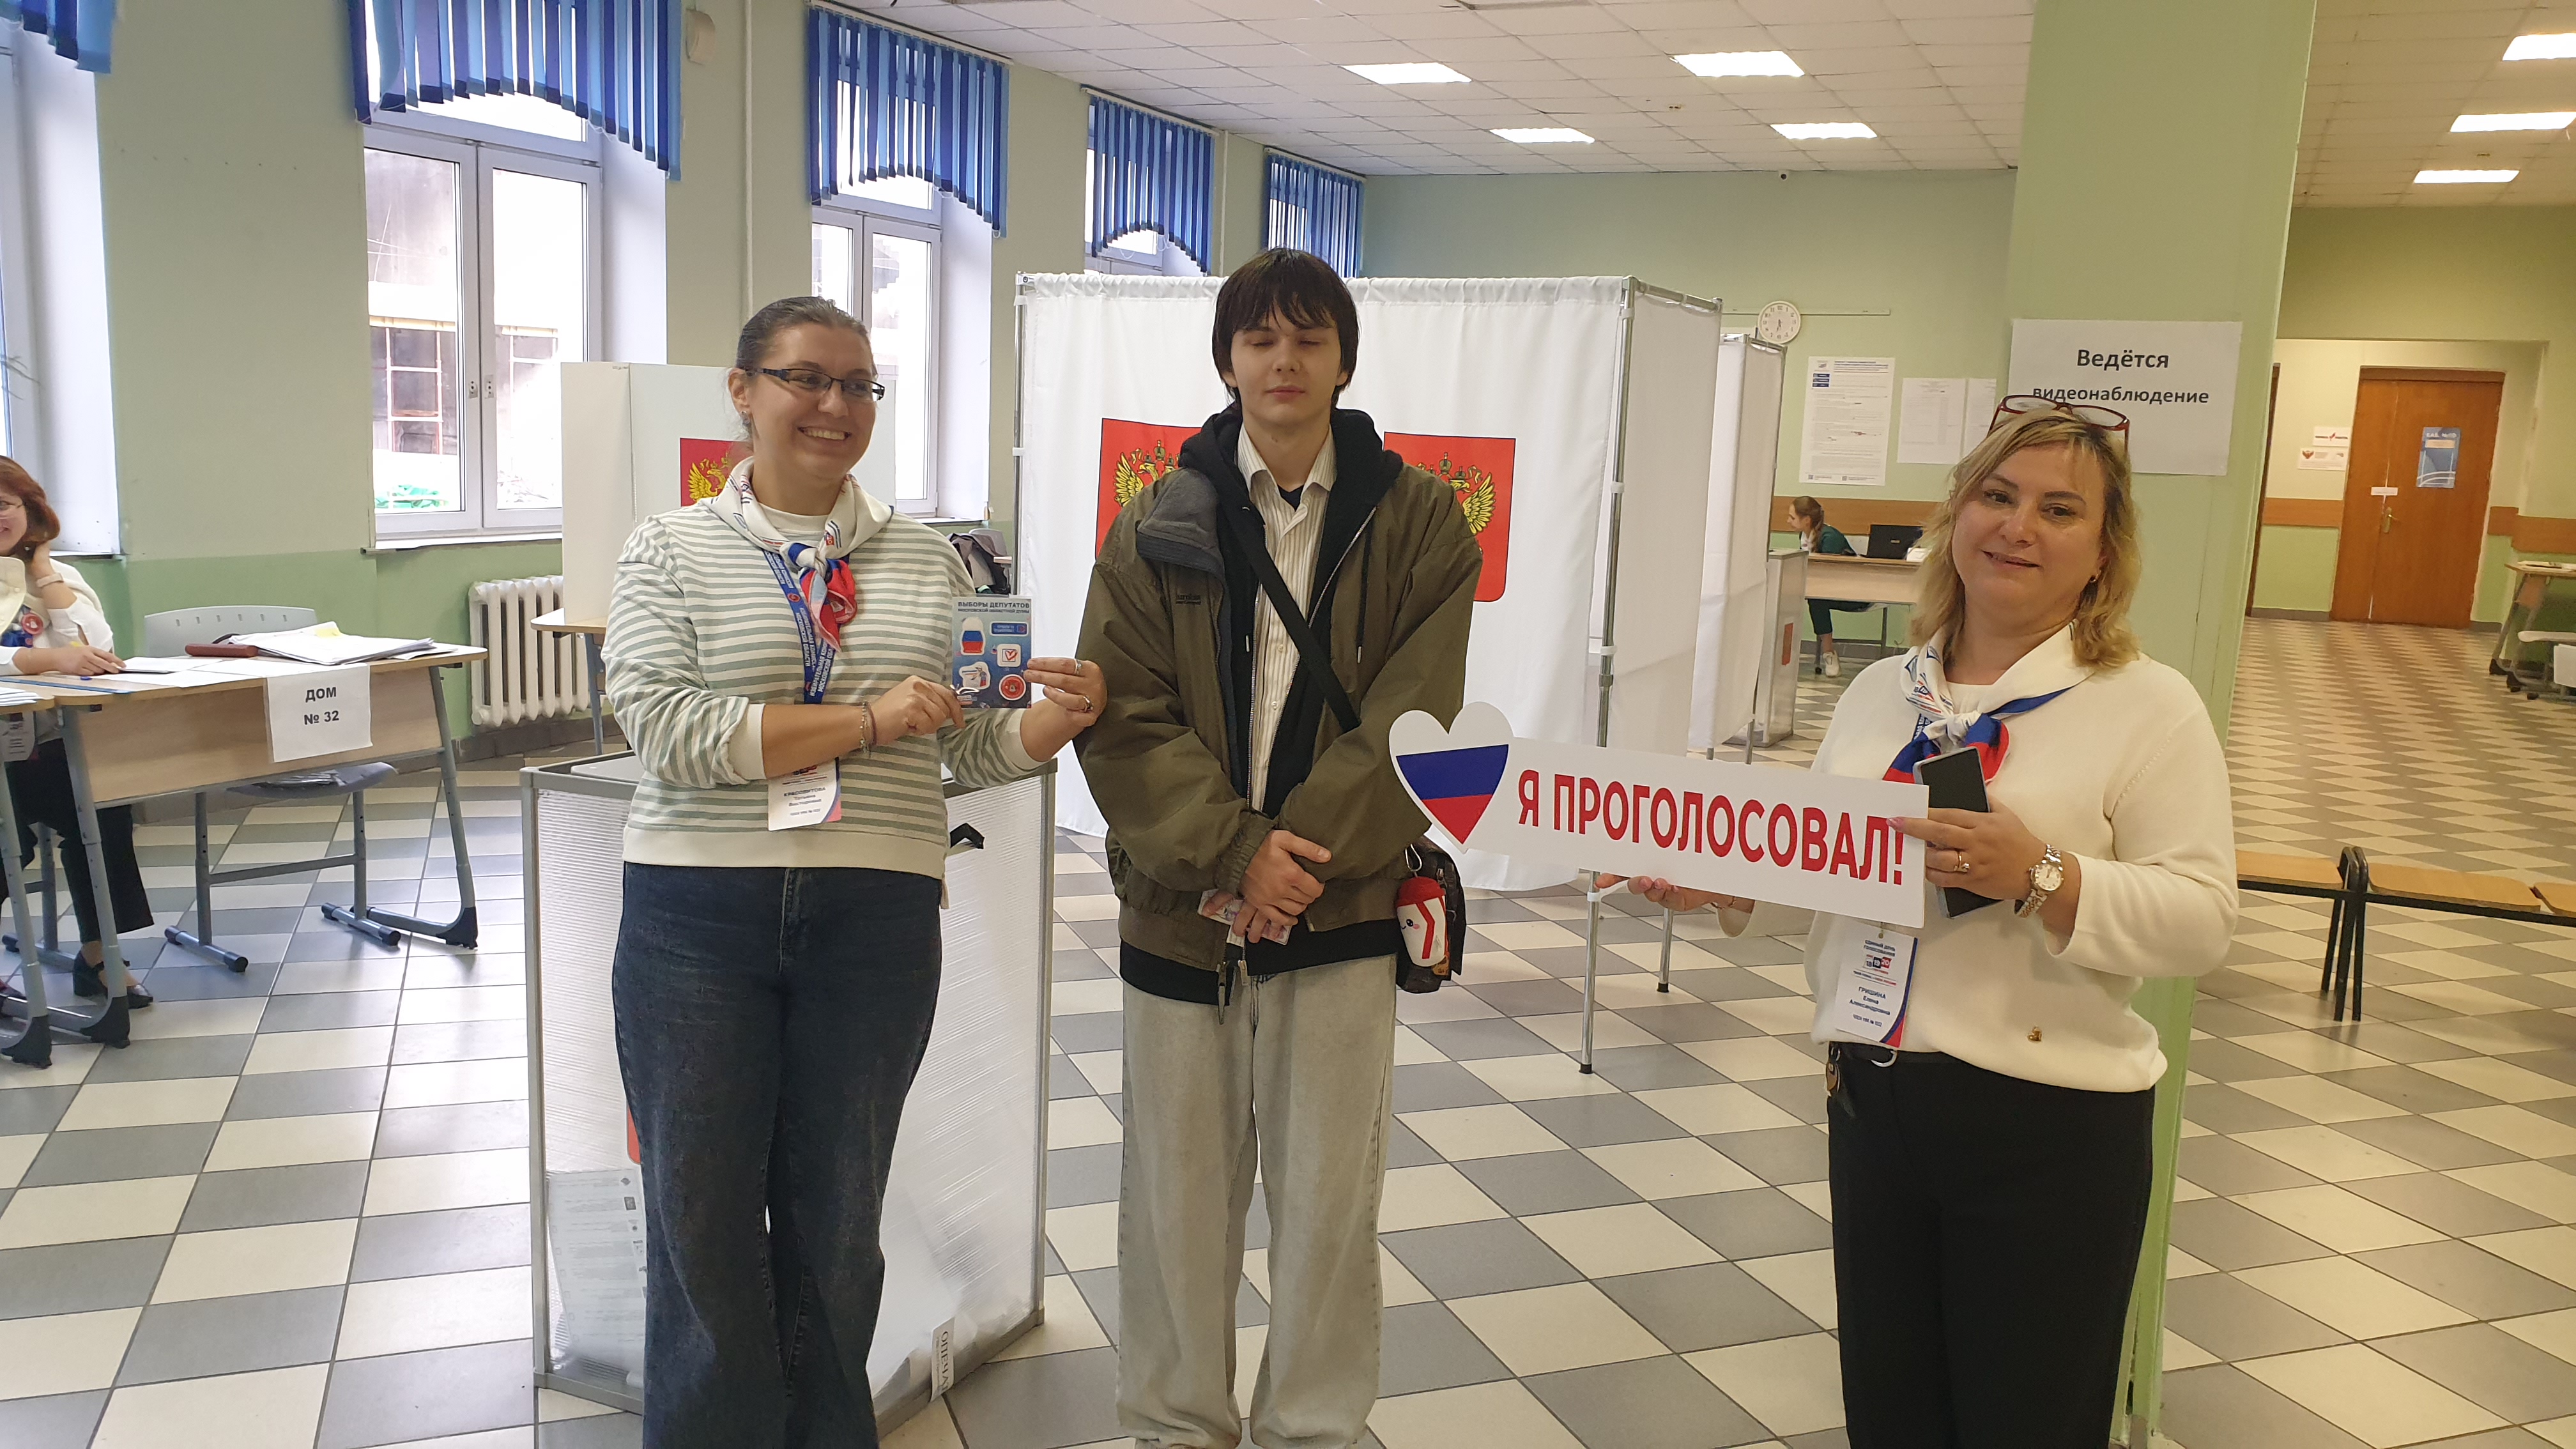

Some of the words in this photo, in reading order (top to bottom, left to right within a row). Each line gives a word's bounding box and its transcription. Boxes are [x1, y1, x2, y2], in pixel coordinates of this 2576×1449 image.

[2077, 349, 2169, 371] Ведётся
[2032, 387, 2209, 404] видеонаблюдение
[305, 687, 337, 703] ДОМ
[303, 714, 319, 725] №
[324, 710, 339, 723] 32
[1518, 769, 1539, 827] Я
[1554, 773, 1904, 885] ПРОГОЛОСОВАЛ!
